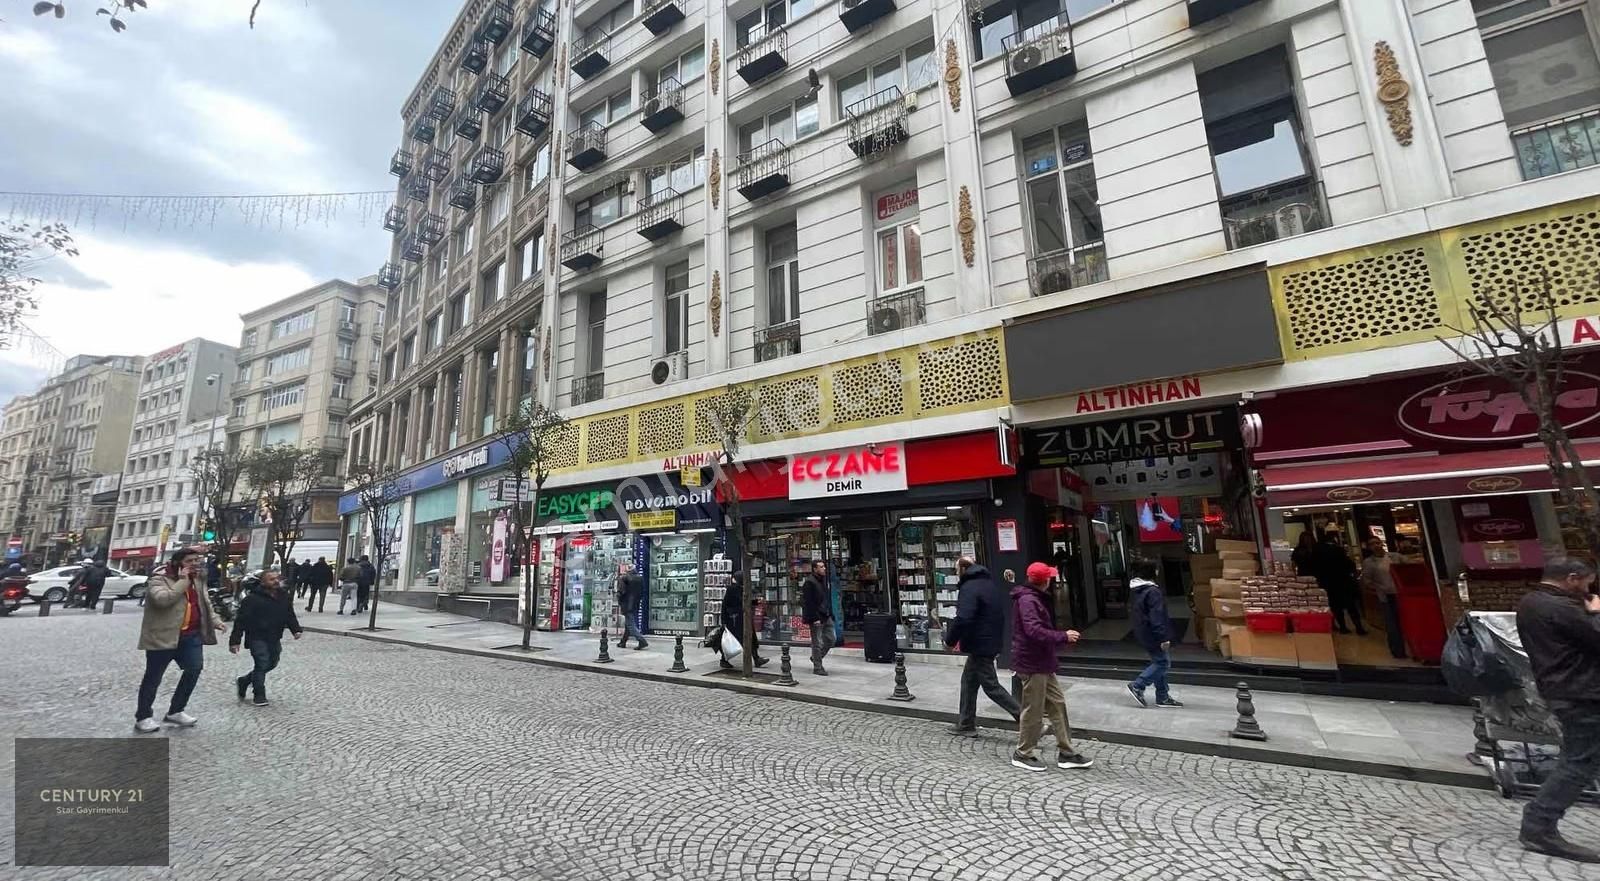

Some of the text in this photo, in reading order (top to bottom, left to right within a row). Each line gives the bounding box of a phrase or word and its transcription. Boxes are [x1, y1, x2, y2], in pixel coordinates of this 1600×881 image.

[1076, 377, 1202, 413] ALTINHAN
[663, 450, 722, 471] ALTINHAN
[792, 446, 899, 482] ECZANE
[826, 477, 862, 492] DEMİR
